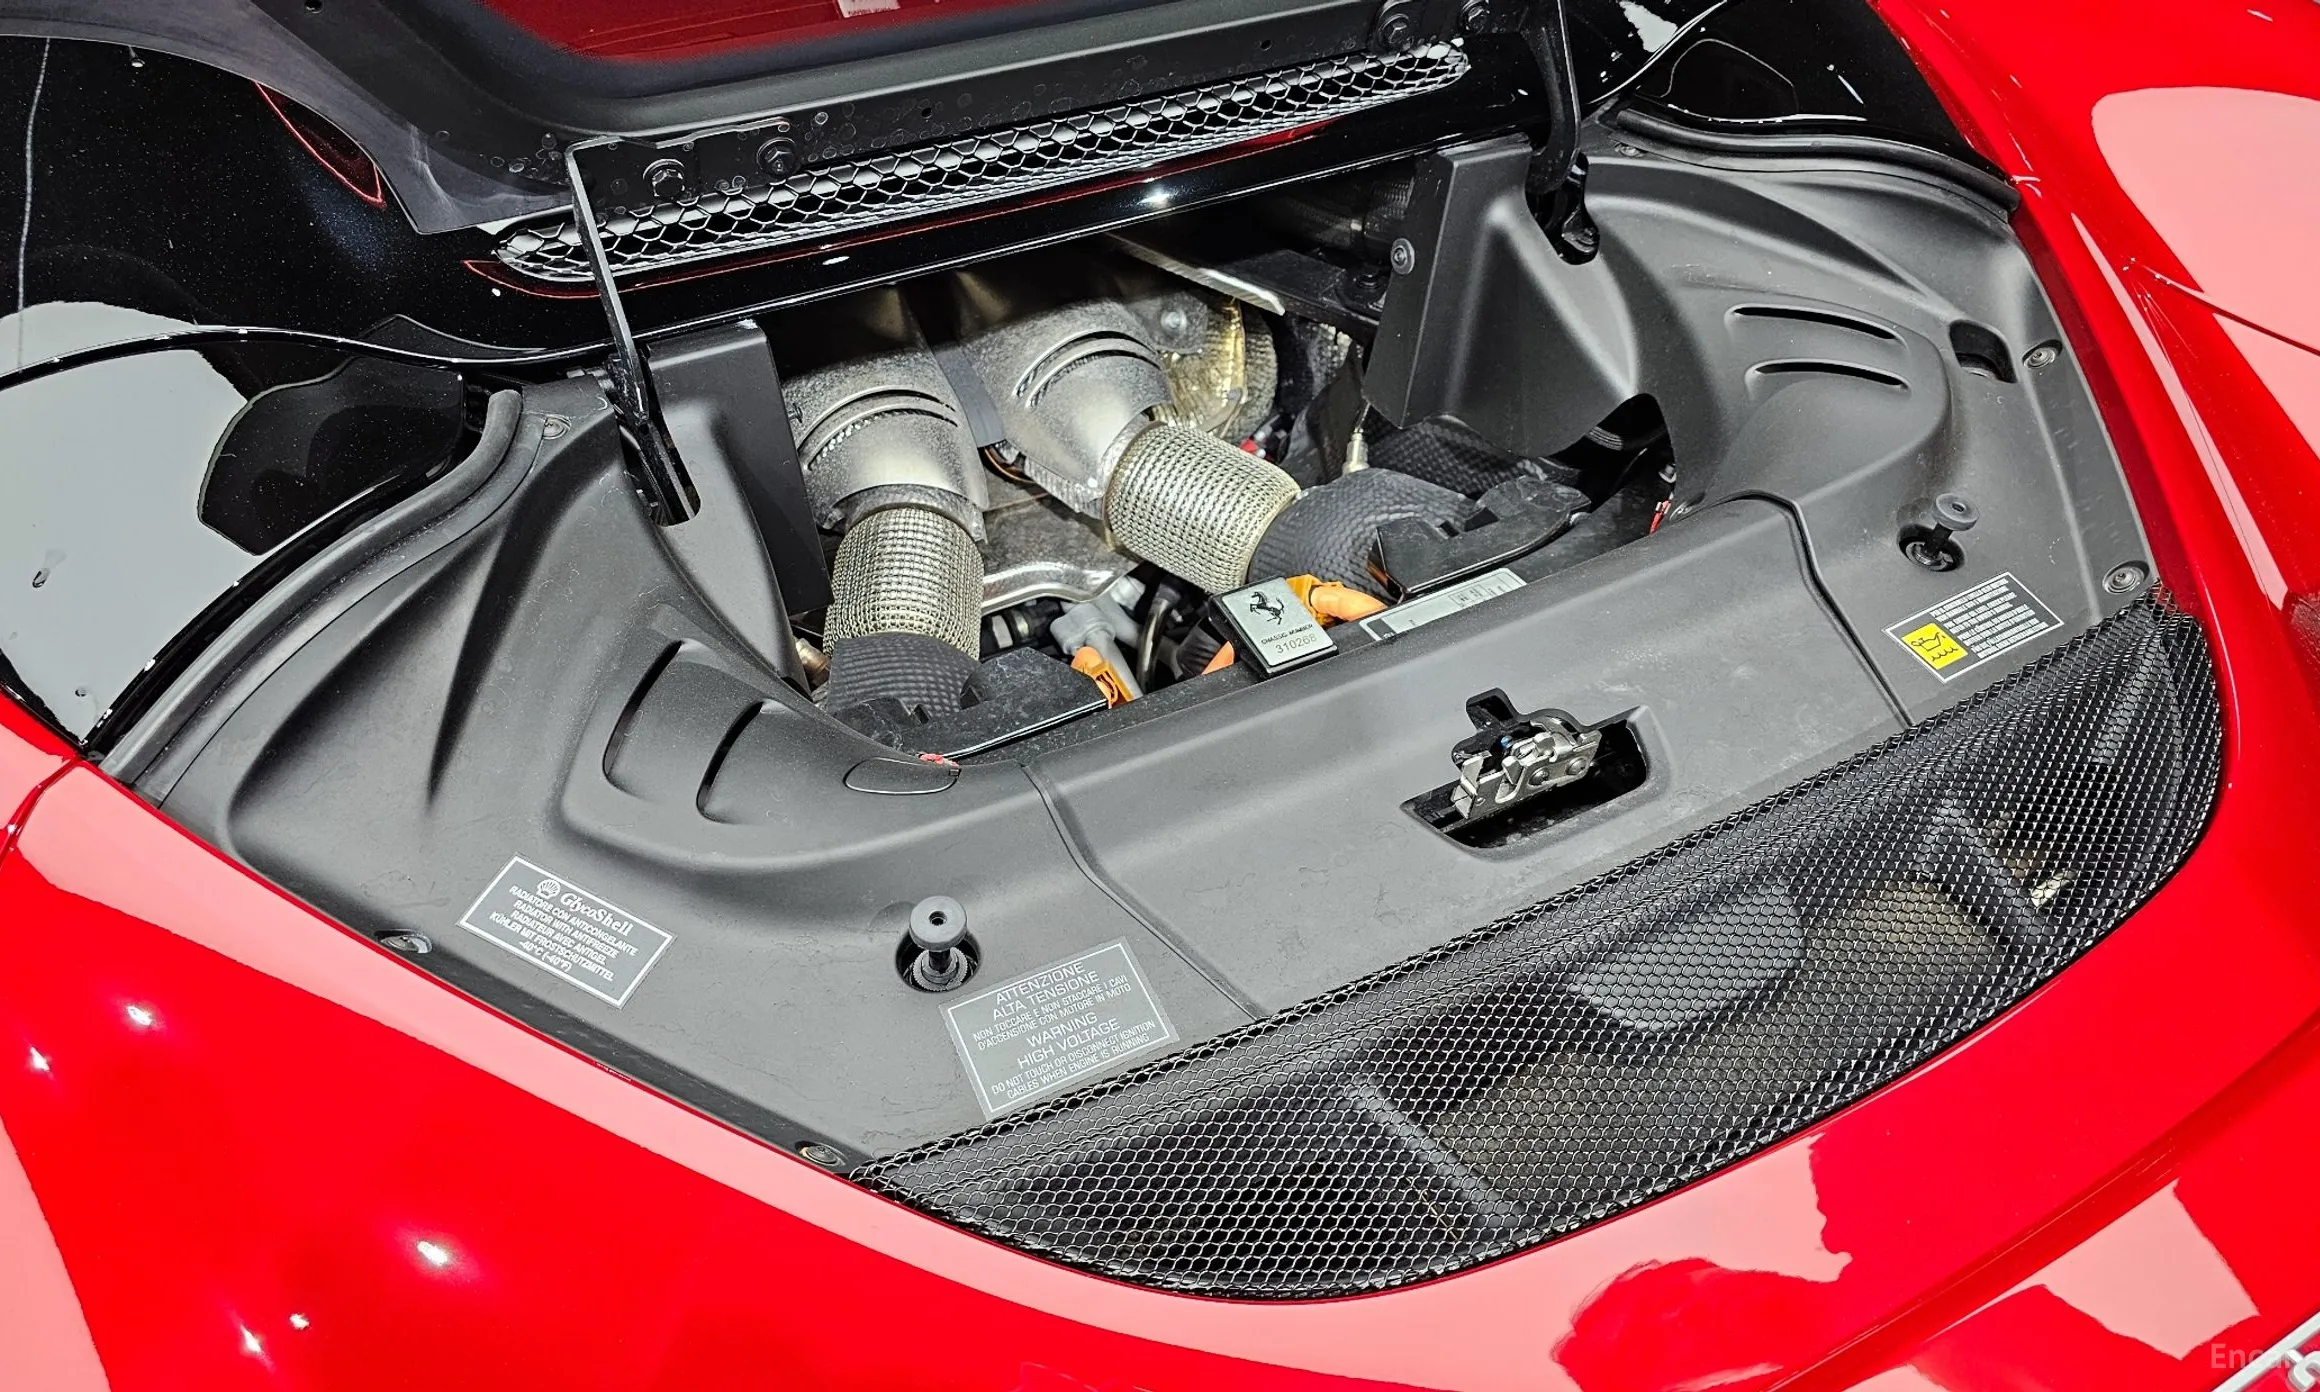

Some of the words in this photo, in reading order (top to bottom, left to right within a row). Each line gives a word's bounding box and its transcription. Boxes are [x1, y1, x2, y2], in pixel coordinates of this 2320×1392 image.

[1275, 633, 1317, 654] 310268
[509, 885, 554, 912] RADIATORE
[552, 907, 572, 922] CON
[568, 916, 639, 956] ANTICONGELANTE
[510, 910, 556, 938] RADIATEUR
[552, 932, 576, 949] AVEC
[573, 943, 607, 966] ANTIGEL
[513, 899, 554, 925] RADIATOR
[552, 918, 574, 936] WITH
[571, 930, 620, 959] ANTIFREEZE
[560, 892, 634, 937] GlycoShell
[489, 911, 523, 934] KÜHLER
[520, 926, 537, 941] MIT
[534, 935, 614, 982] FROSTSCHUTZMITTEL
[973, 1026, 994, 1042] NON
[993, 1011, 1032, 1034] TOCCARE
[1033, 1008, 1041, 1018] E
[1041, 999, 1061, 1015] NON
[1062, 984, 1103, 1006] STACCARE
[1108, 974, 1129, 988] CAVI
[993, 999, 1027, 1021] ALTA
[1026, 970, 1101, 1006] TENSIONE
[995, 961, 1086, 1005] ATTENZIONE
[977, 1020, 1039, 1051] D'ACCENSIONE
[1039, 1012, 1059, 1026] CON
[1058, 997, 1095, 1018] MOTORE
[1095, 992, 1106, 1004] IN
[1106, 982, 1132, 999] MOTO
[1017, 1044, 1056, 1070] HIGH
[1056, 1017, 1121, 1052] VOLTAGE
[1026, 1011, 1098, 1048] WARNING
[991, 1082, 1006, 1095] DO
[1006, 1072, 1024, 1089] NOT
[1024, 1061, 1054, 1080] TOUCH
[1054, 1055, 1068, 1068] OR
[1067, 1033, 1119, 1063] DISCONNECT
[1119, 1019, 1157, 1041] IGNITION
[1007, 1078, 1040, 1099] CABLES
[1040, 1066, 1069, 1084] WHEN
[1068, 1052, 1100, 1073] ENGINE
[1100, 1047, 1111, 1059] IS
[1111, 1032, 1151, 1056] RUNNING
